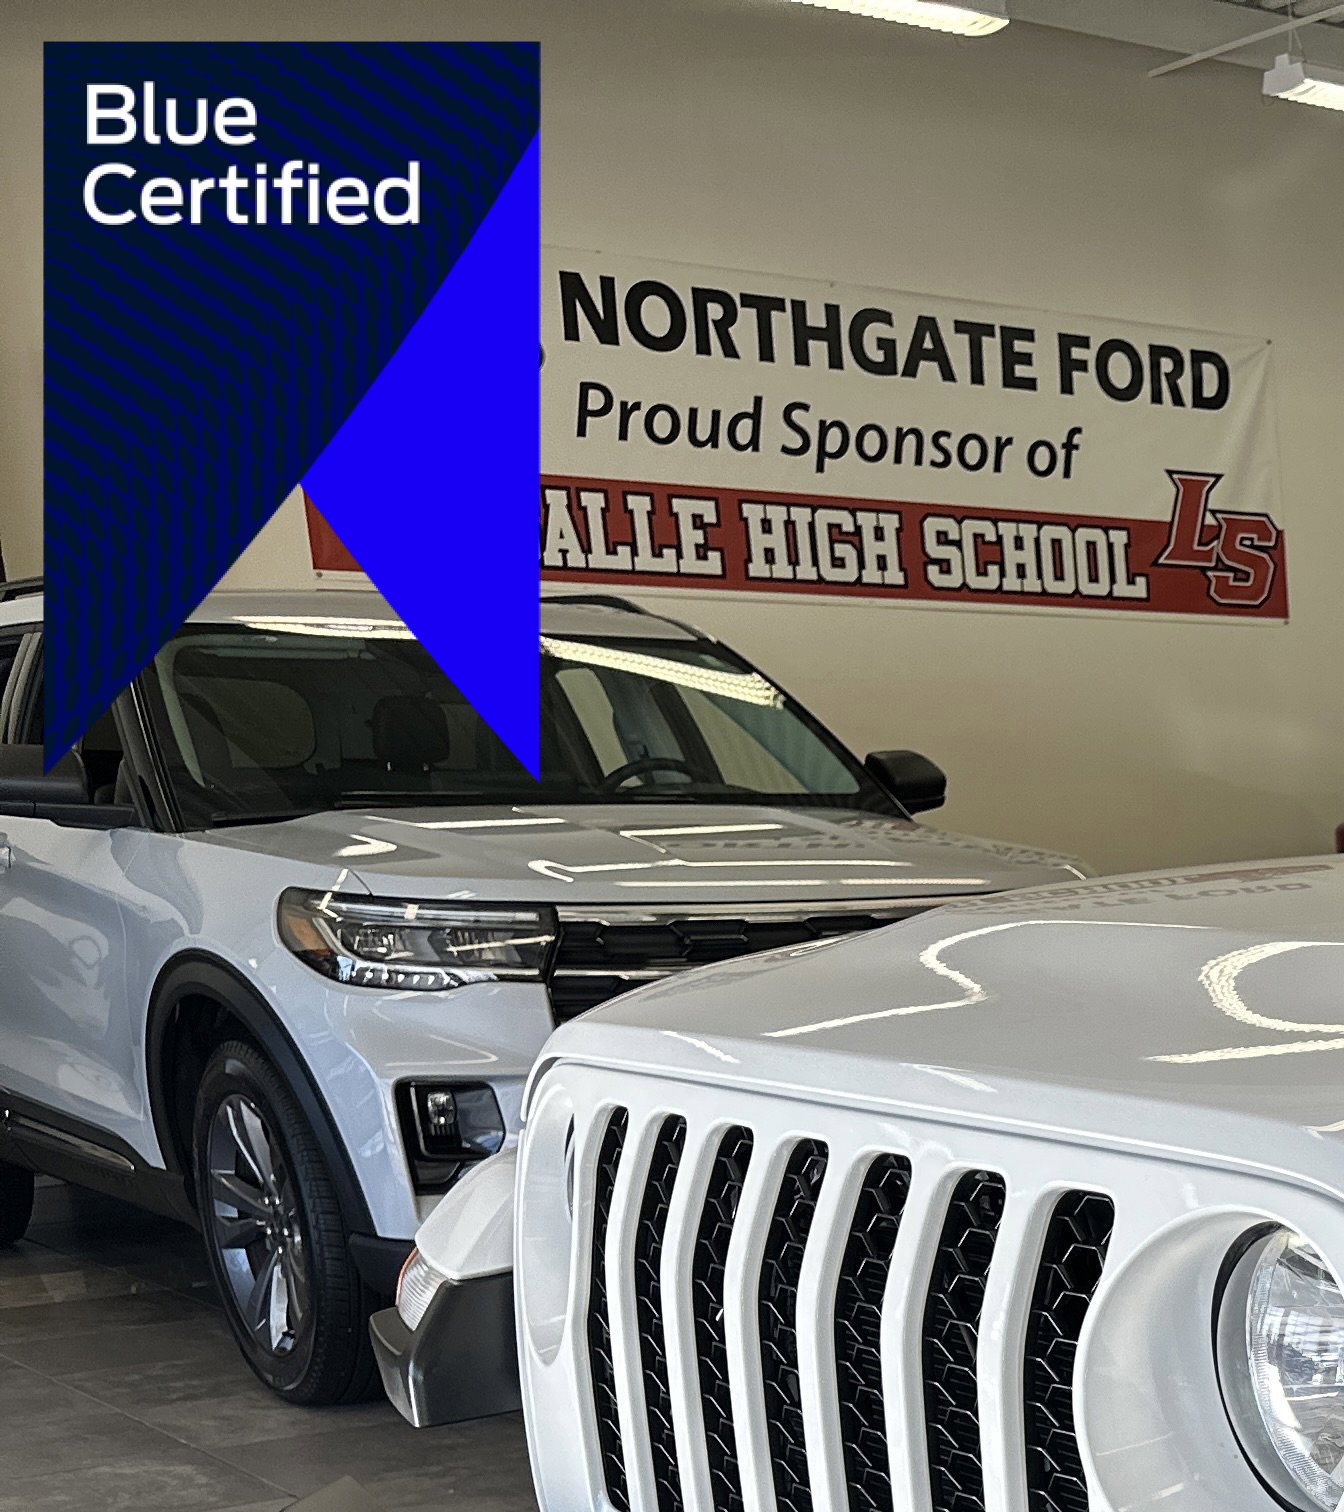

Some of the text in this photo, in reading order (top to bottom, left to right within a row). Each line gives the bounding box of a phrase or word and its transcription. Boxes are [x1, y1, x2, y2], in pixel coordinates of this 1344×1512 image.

[558, 270, 1232, 412] NORTHGATE FORD
[575, 380, 1084, 480] Proud Sponsor of
[540, 484, 1150, 602] ALLE HIGH SCHOOL
